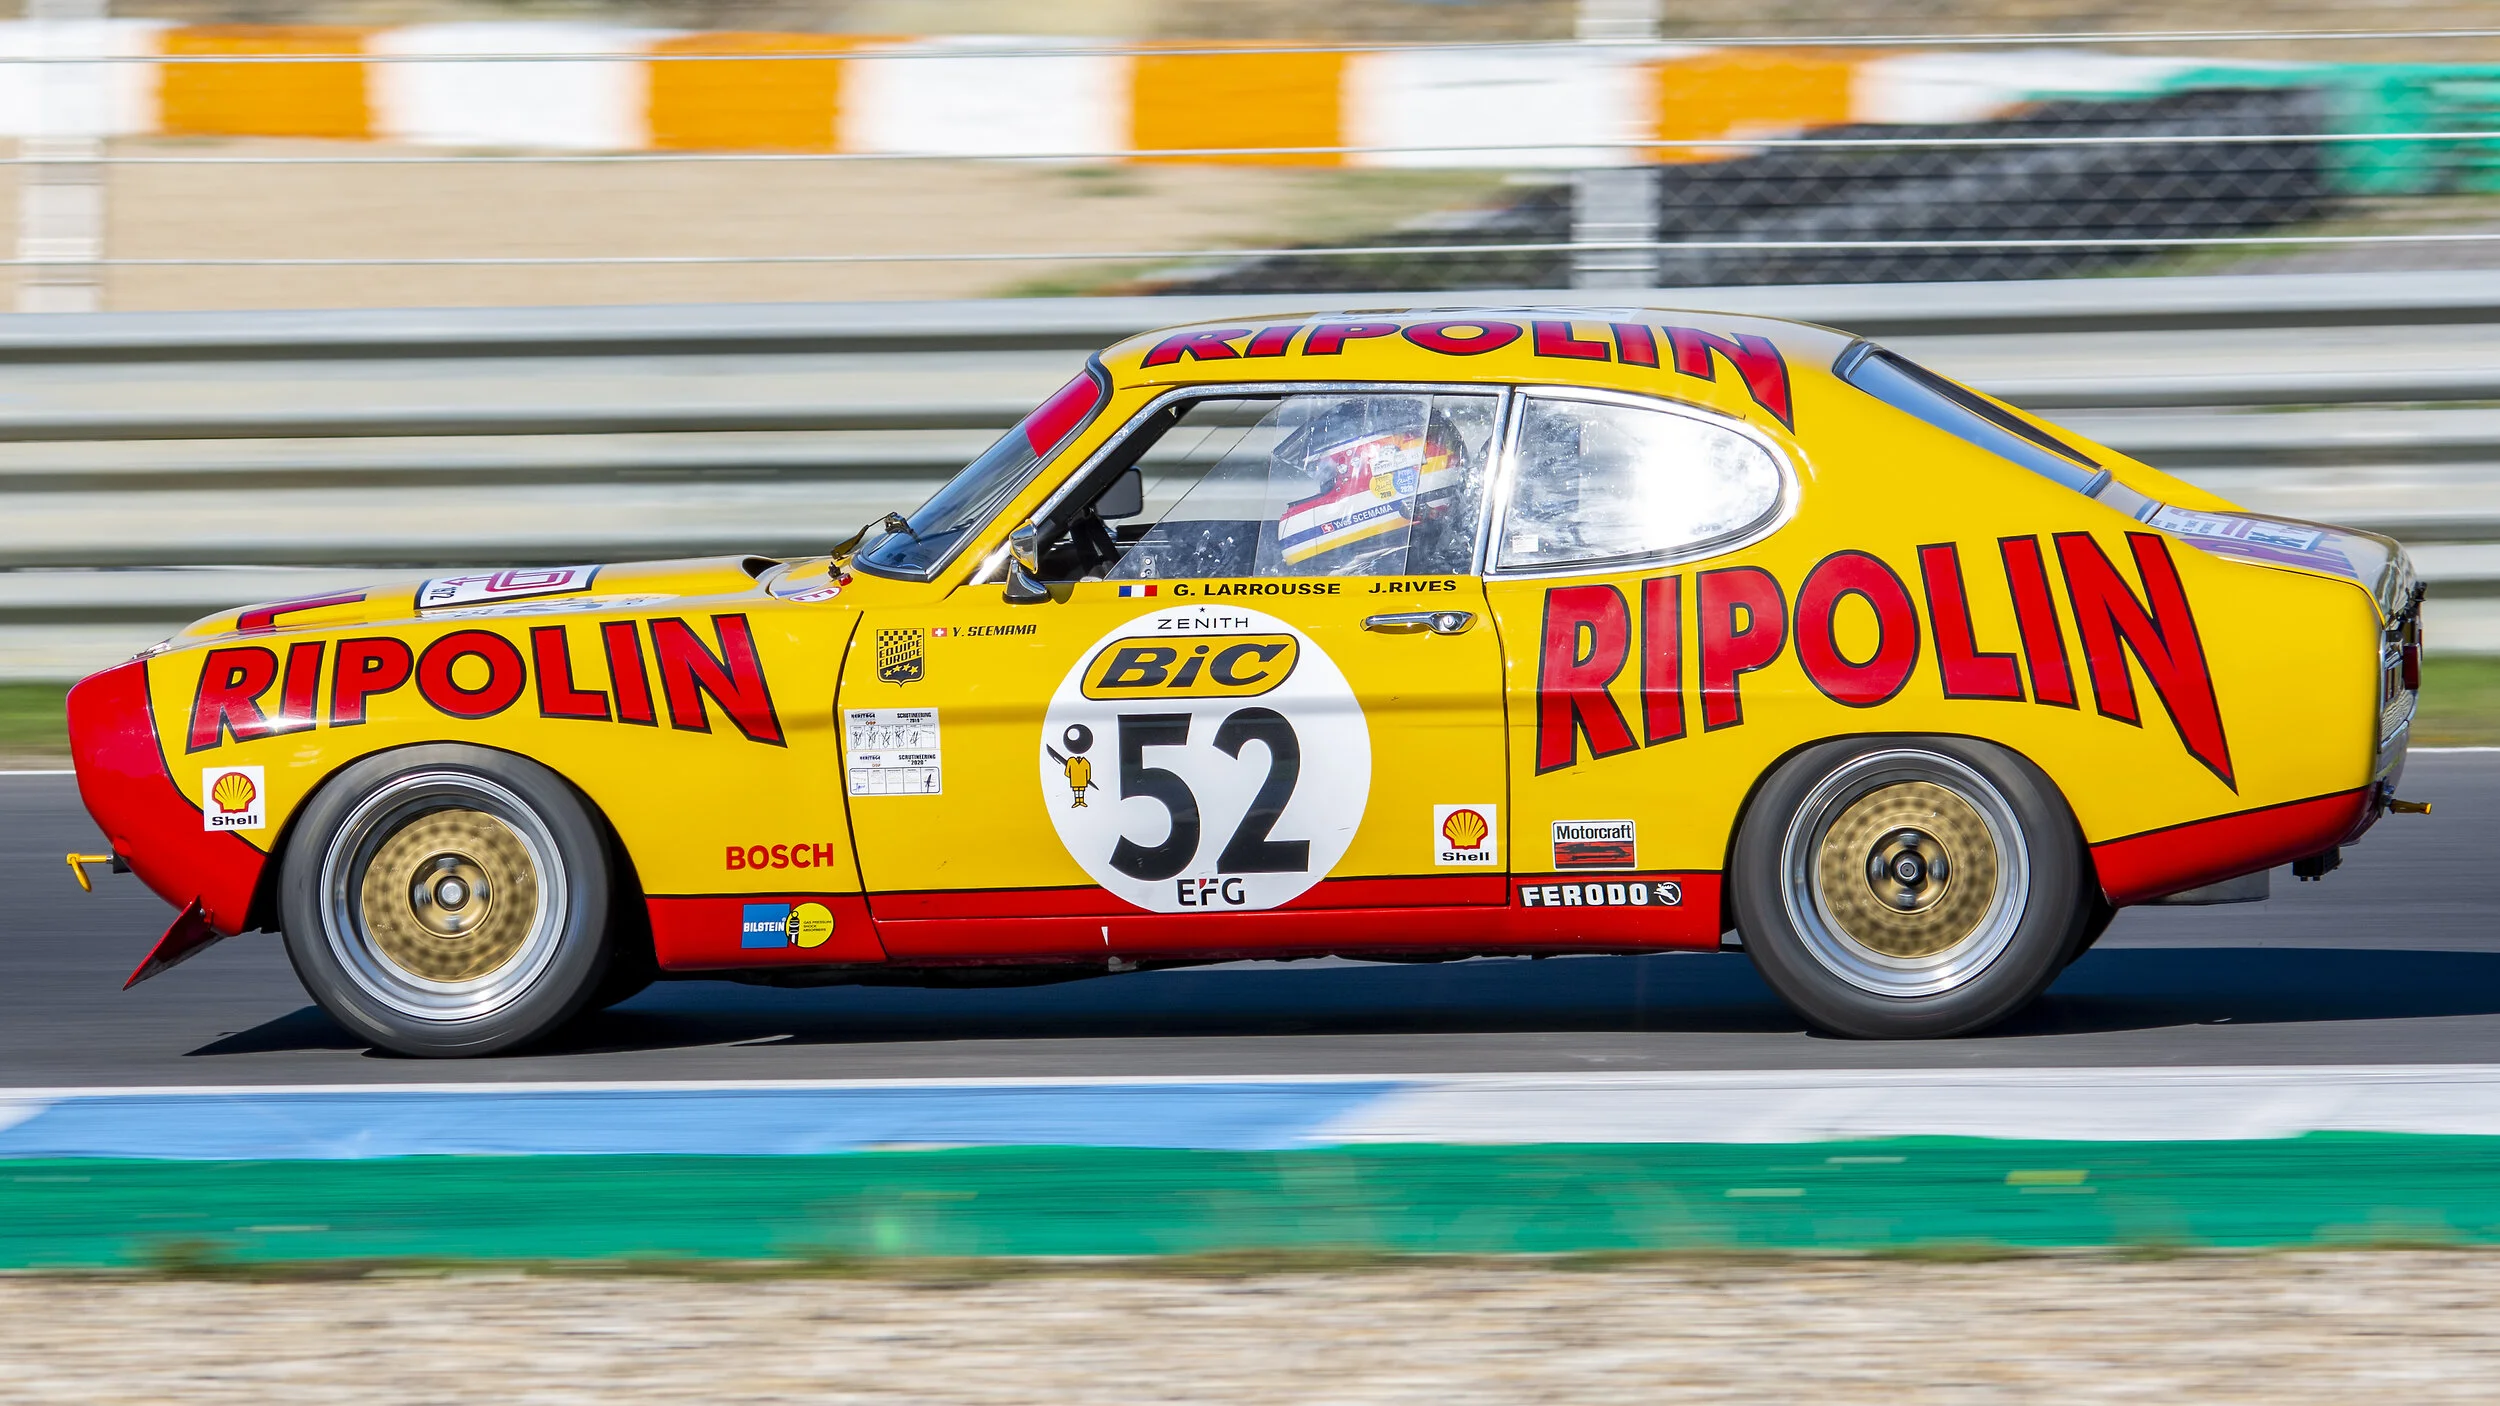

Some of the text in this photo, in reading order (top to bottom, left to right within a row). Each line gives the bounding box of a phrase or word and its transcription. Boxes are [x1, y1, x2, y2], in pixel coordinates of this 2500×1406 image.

[1140, 319, 1795, 434] RIPOLIN
[1352, 504, 1393, 524] SCEMAMA
[1173, 583, 1196, 597] G.
[1203, 582, 1341, 597] LARROUSSE
[952, 624, 1037, 637] Y. SCEMAMA
[1157, 617, 1249, 630] ZENITH
[879, 638, 922, 659] EQUIPE
[879, 648, 922, 668] EUROPE
[1535, 530, 2238, 795] RIPOLIN
[186, 613, 788, 754] RIPOLIN
[1109, 706, 1311, 881] 52
[211, 814, 258, 826] Shell
[1556, 824, 1633, 840] Motorcraft
[726, 843, 834, 870] BOSCH
[1442, 851, 1490, 862] Shell
[1177, 877, 1246, 906] EFG
[1521, 883, 1648, 907] FERODO
[743, 920, 786, 933] BILSTEIN
